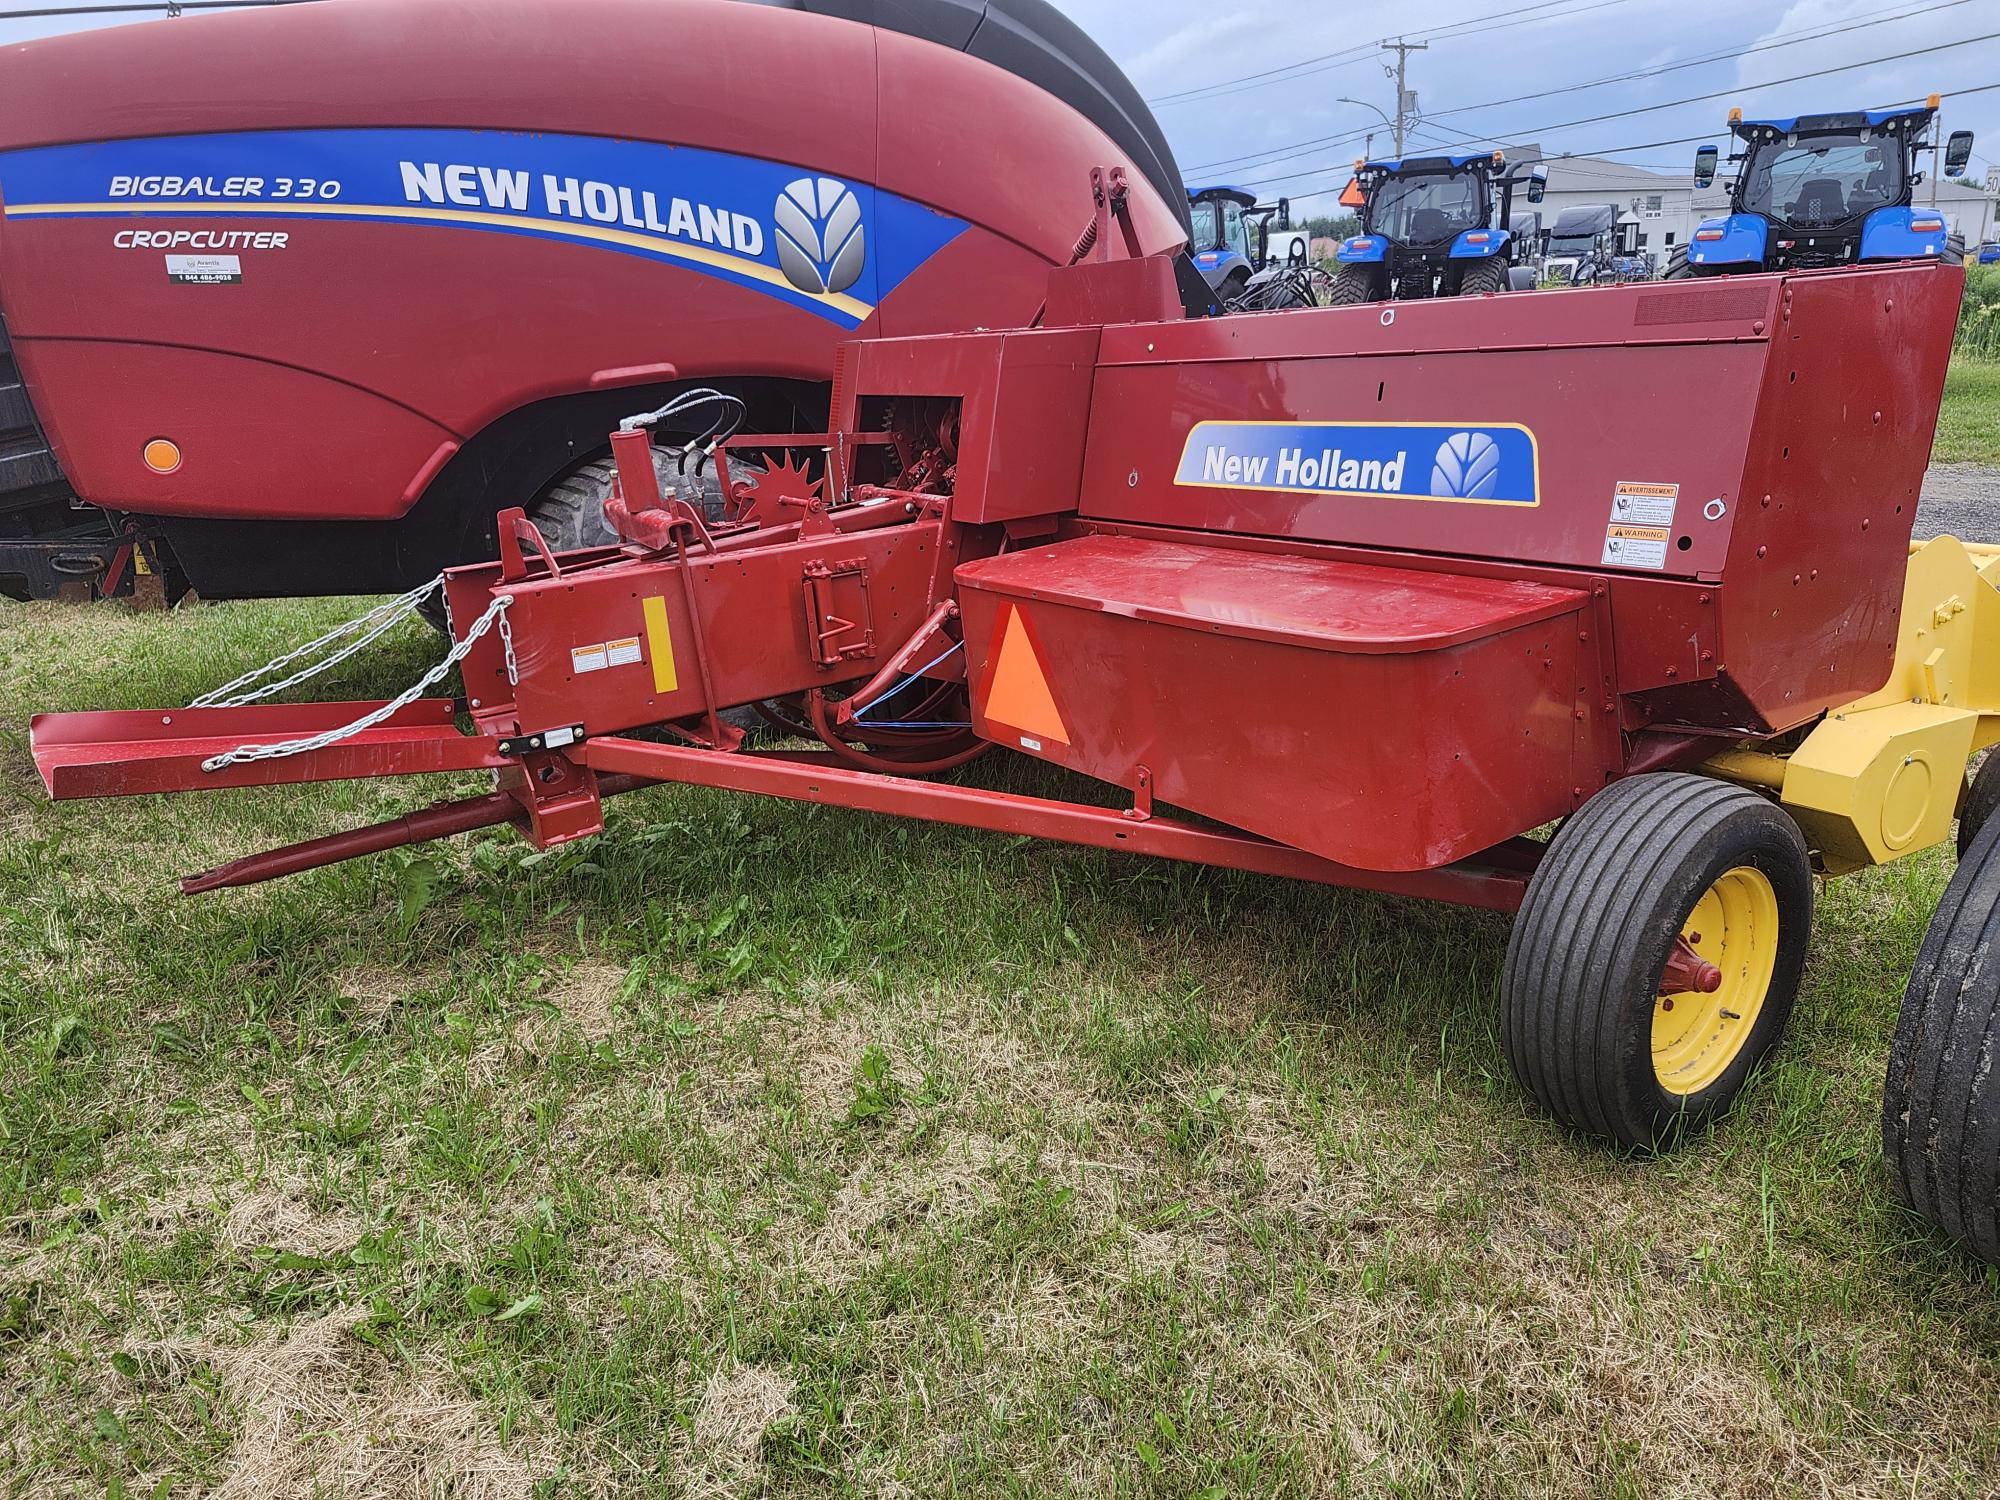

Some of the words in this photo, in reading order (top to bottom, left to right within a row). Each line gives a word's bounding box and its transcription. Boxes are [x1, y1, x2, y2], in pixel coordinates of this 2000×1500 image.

[108, 175, 265, 198] BIGBALER
[271, 177, 342, 199] 330
[1986, 177, 1998, 192] 50
[399, 160, 530, 211] NEW
[543, 173, 765, 257] HOLLAND
[112, 230, 290, 250] CROPCUTTER
[1202, 445, 1270, 484] New
[1275, 447, 1407, 492] Holland
[1628, 485, 1675, 495] AVERTISSEMENT
[1624, 529, 1663, 539] WARNING
